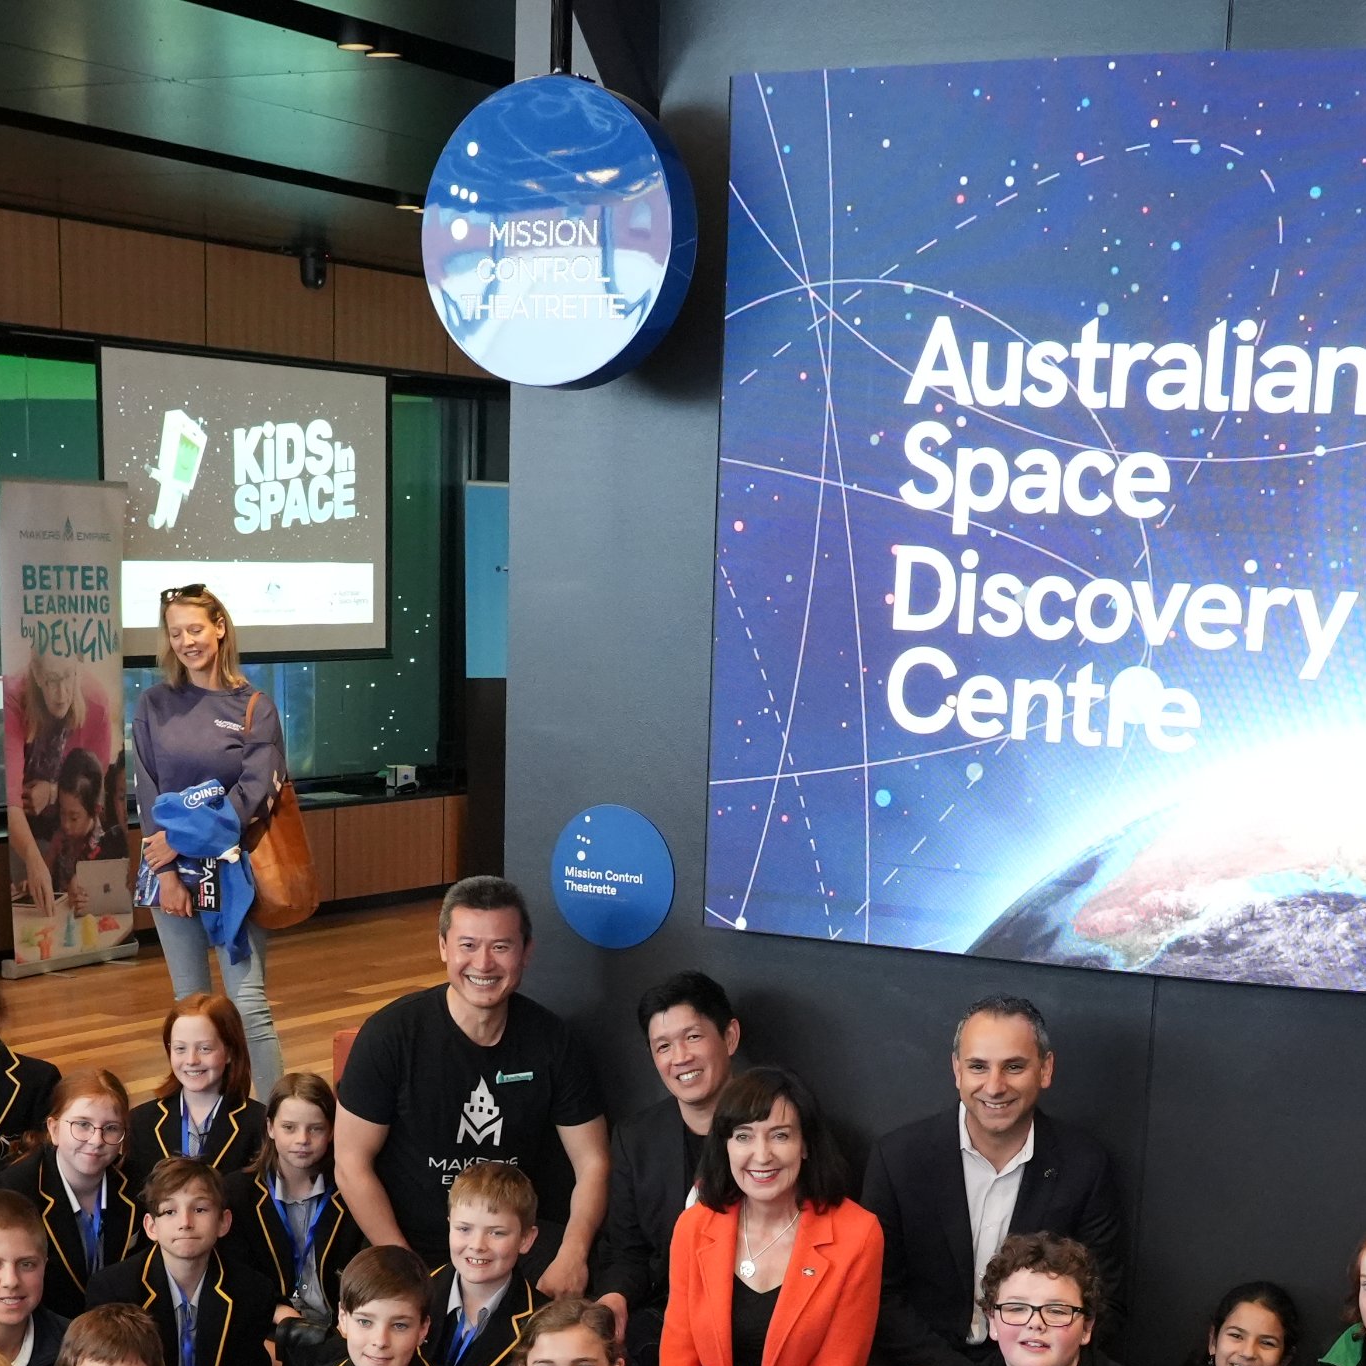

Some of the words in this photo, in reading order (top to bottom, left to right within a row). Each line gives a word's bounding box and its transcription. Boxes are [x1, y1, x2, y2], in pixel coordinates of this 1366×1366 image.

[489, 219, 598, 247] MISSION
[476, 256, 611, 284] CONTROL
[461, 293, 626, 321] THEATRETTE
[899, 420, 1171, 534] Space
[233, 471, 357, 535] SPACE
[19, 530, 60, 541] MAKERS
[76, 531, 112, 542] EMPIRE
[21, 565, 109, 591] BETTER
[23, 594, 111, 615] LEARNING
[891, 544, 1360, 680] Discovery
[20, 617, 35, 648] by
[887, 647, 1202, 752] Centre
[564, 866, 603, 880] Mission
[604, 870, 643, 884] Control
[564, 879, 617, 896] Theatrette
